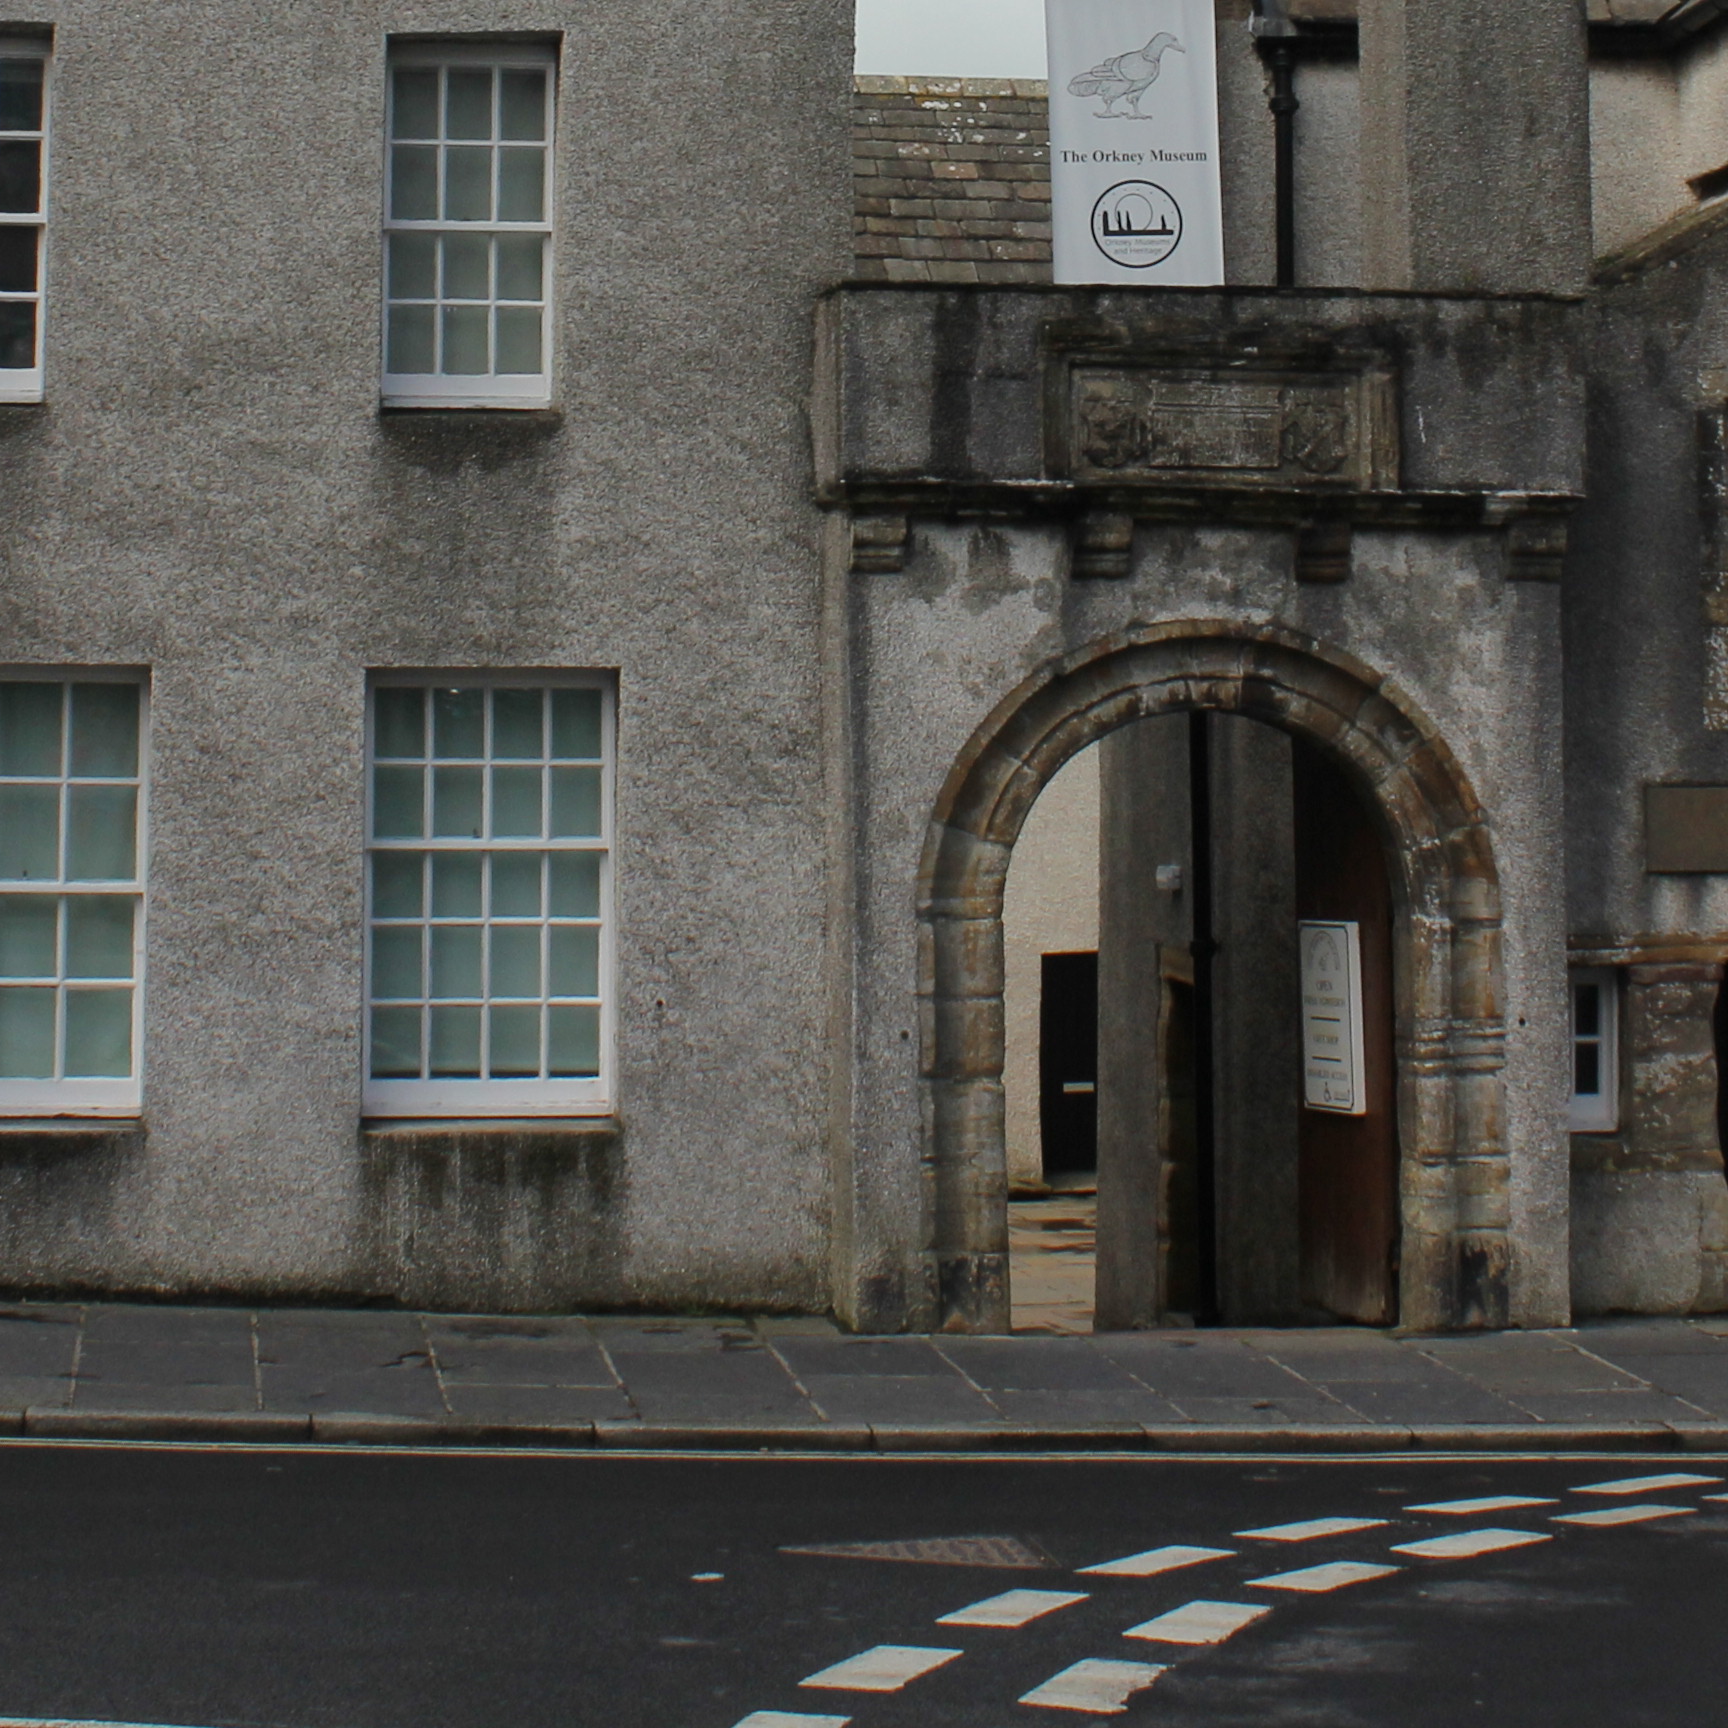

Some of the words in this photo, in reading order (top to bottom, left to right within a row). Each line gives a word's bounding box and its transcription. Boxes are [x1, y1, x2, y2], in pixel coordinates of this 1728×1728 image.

[1060, 150, 1088, 163] The
[1092, 149, 1145, 165] Orkney
[1150, 149, 1208, 162] Museum
[1104, 238, 1132, 247] Orkney
